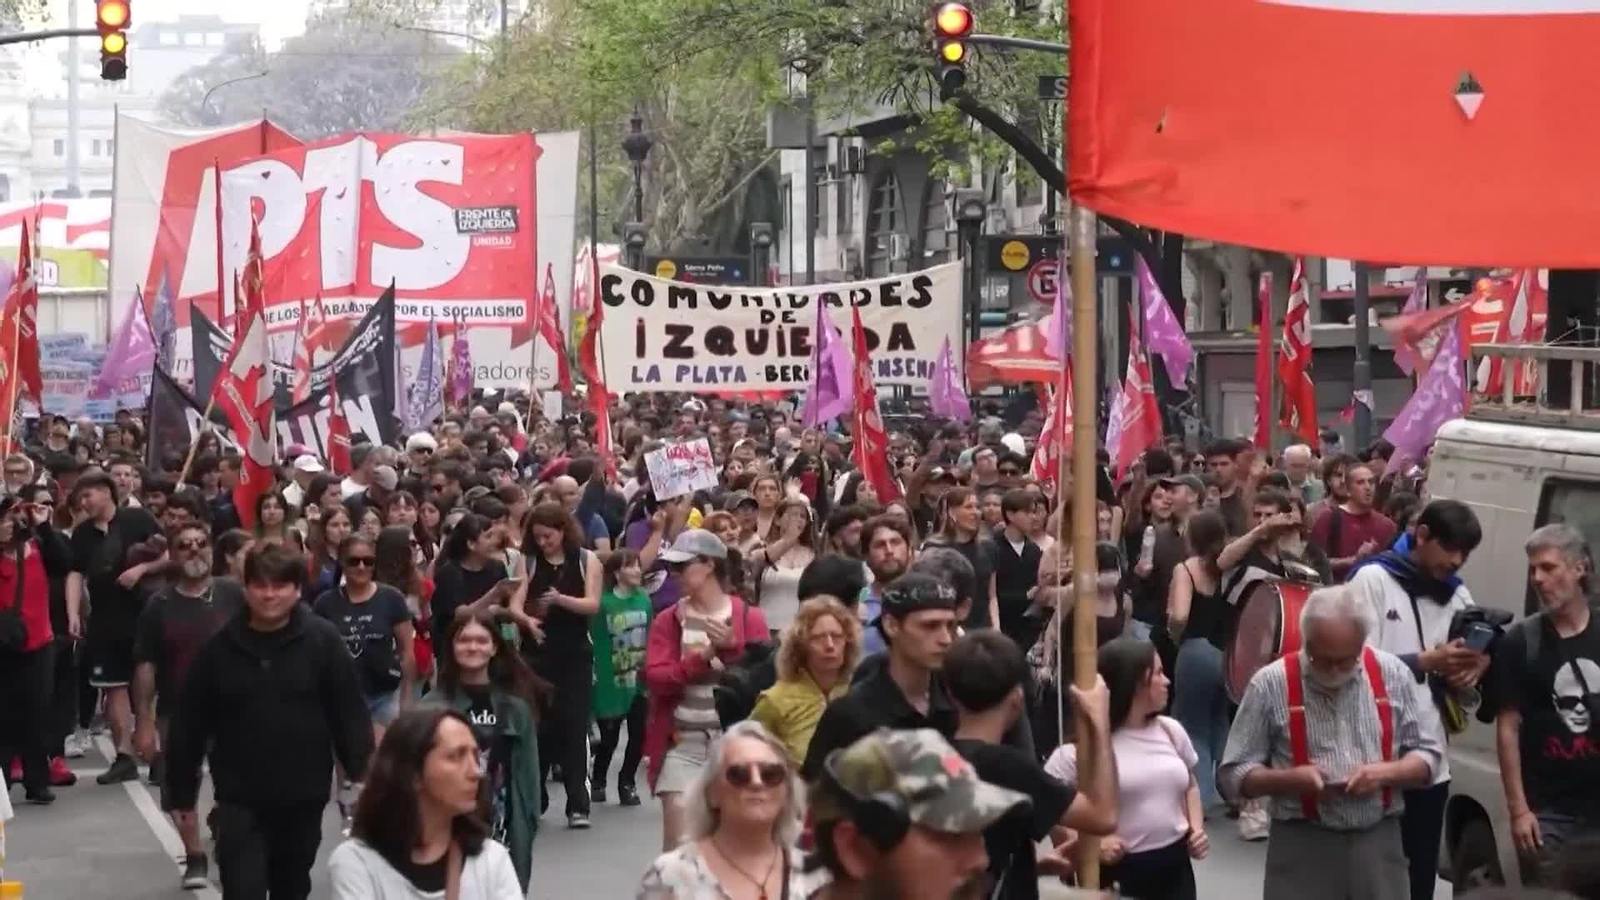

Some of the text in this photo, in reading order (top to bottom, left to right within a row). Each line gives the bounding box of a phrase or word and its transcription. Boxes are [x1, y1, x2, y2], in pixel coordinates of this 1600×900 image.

[459, 208, 500, 219] FRENTE
[221, 136, 471, 317] PTS
[459, 219, 515, 230] IZQUIERDA
[473, 236, 512, 246] UNIDAD
[277, 307, 300, 321] LOS
[421, 305, 438, 317] EL
[443, 305, 524, 318] SOCIALISMO
[761, 309, 797, 324] DE
[631, 364, 661, 383] LA
[676, 364, 747, 384] PLATA
